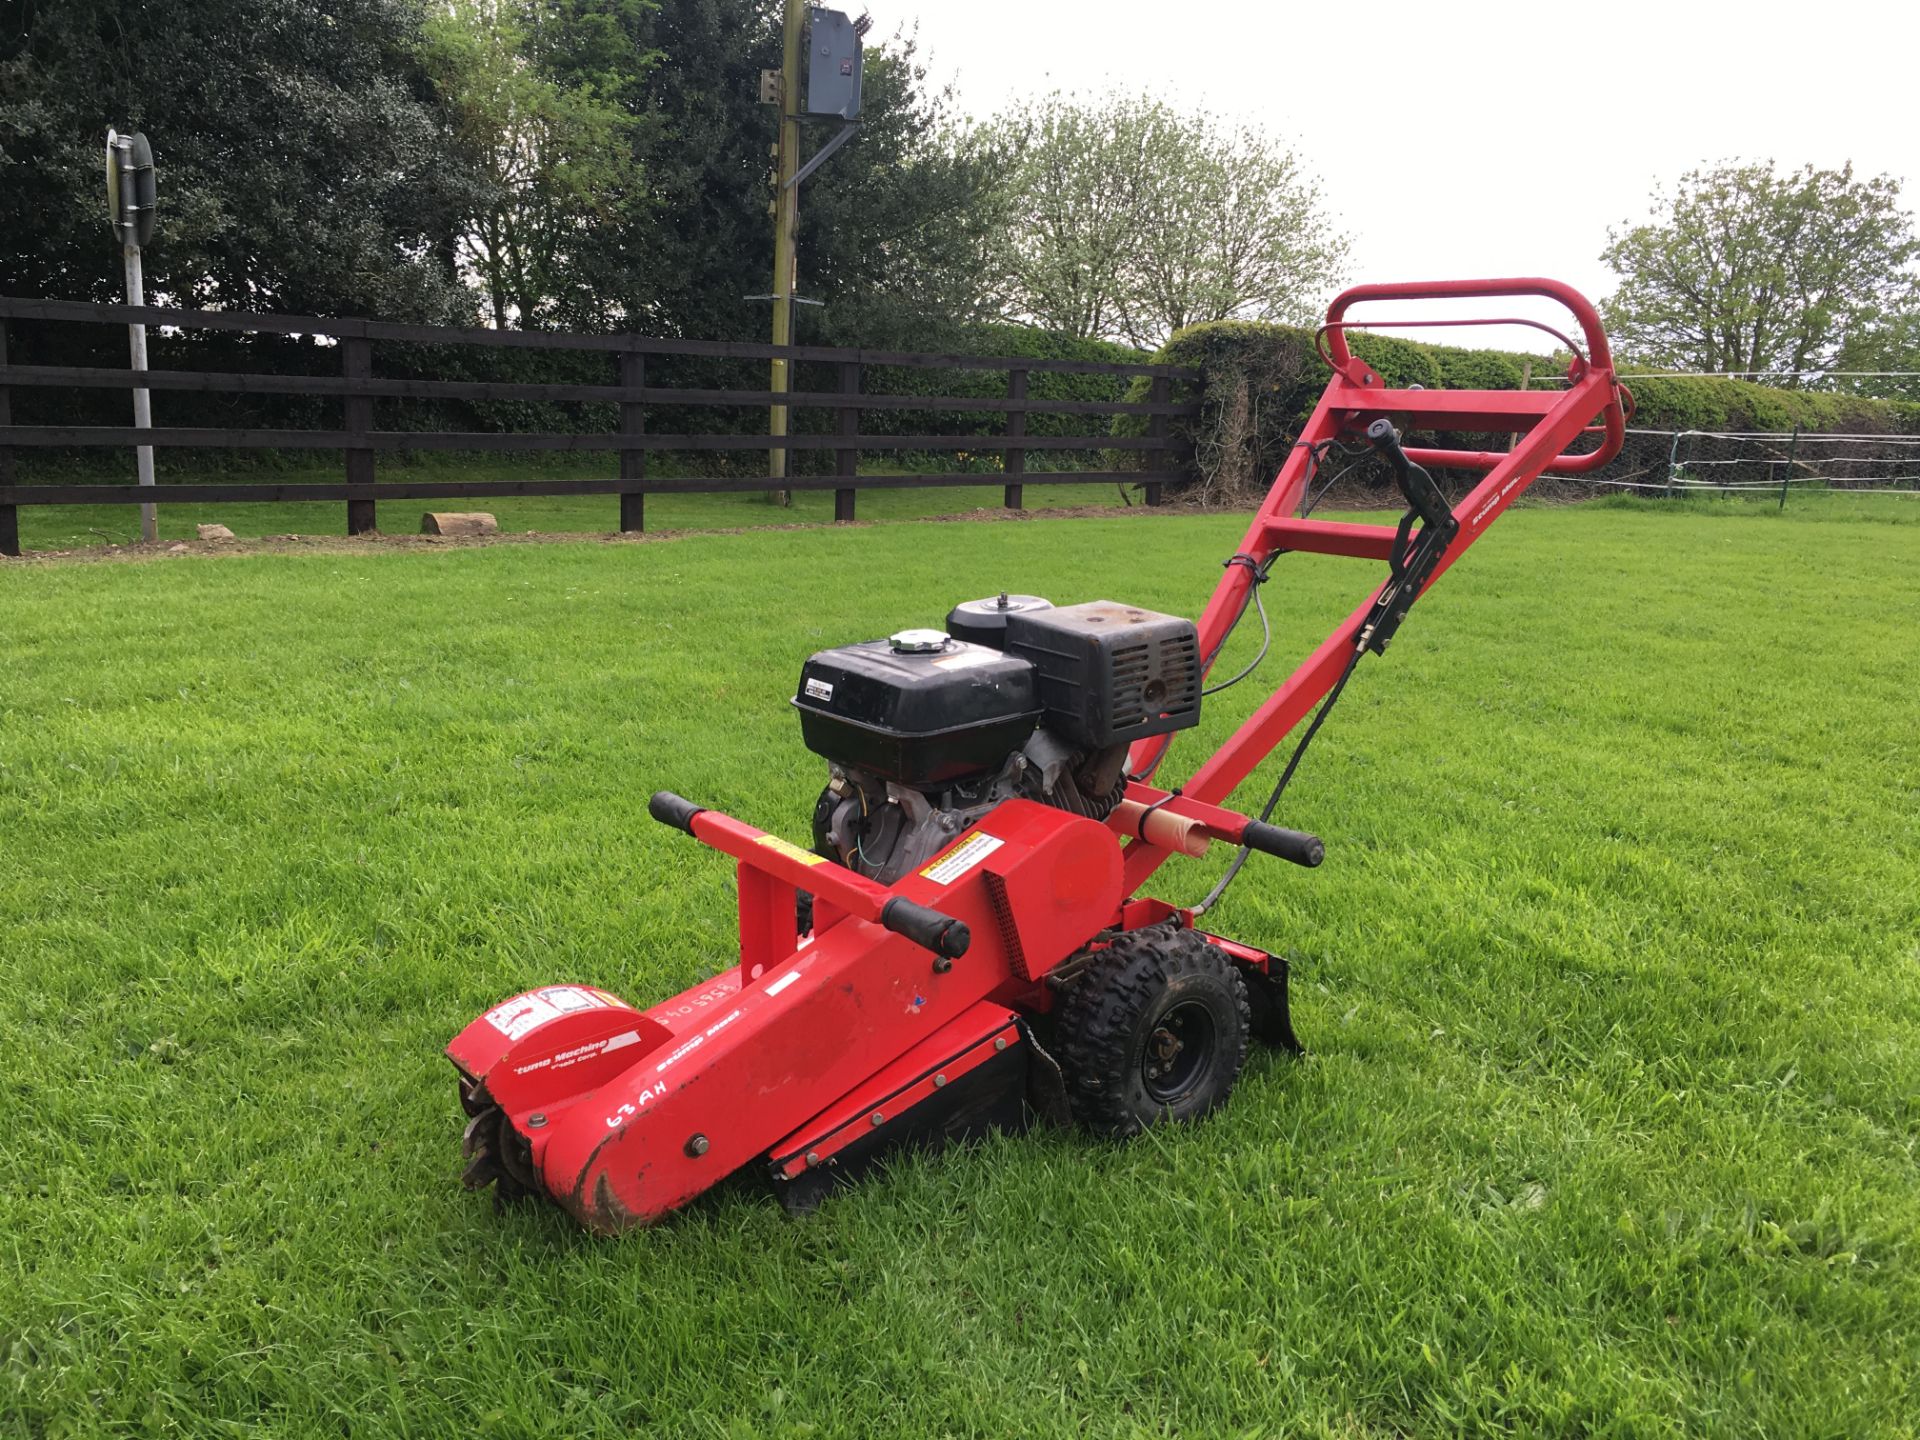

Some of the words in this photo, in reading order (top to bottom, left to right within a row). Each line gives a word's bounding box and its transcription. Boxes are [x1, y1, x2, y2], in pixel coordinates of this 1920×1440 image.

[513, 1058, 552, 1075] tump
[554, 1039, 608, 1062] Machine
[576, 1052, 598, 1063] Corp.
